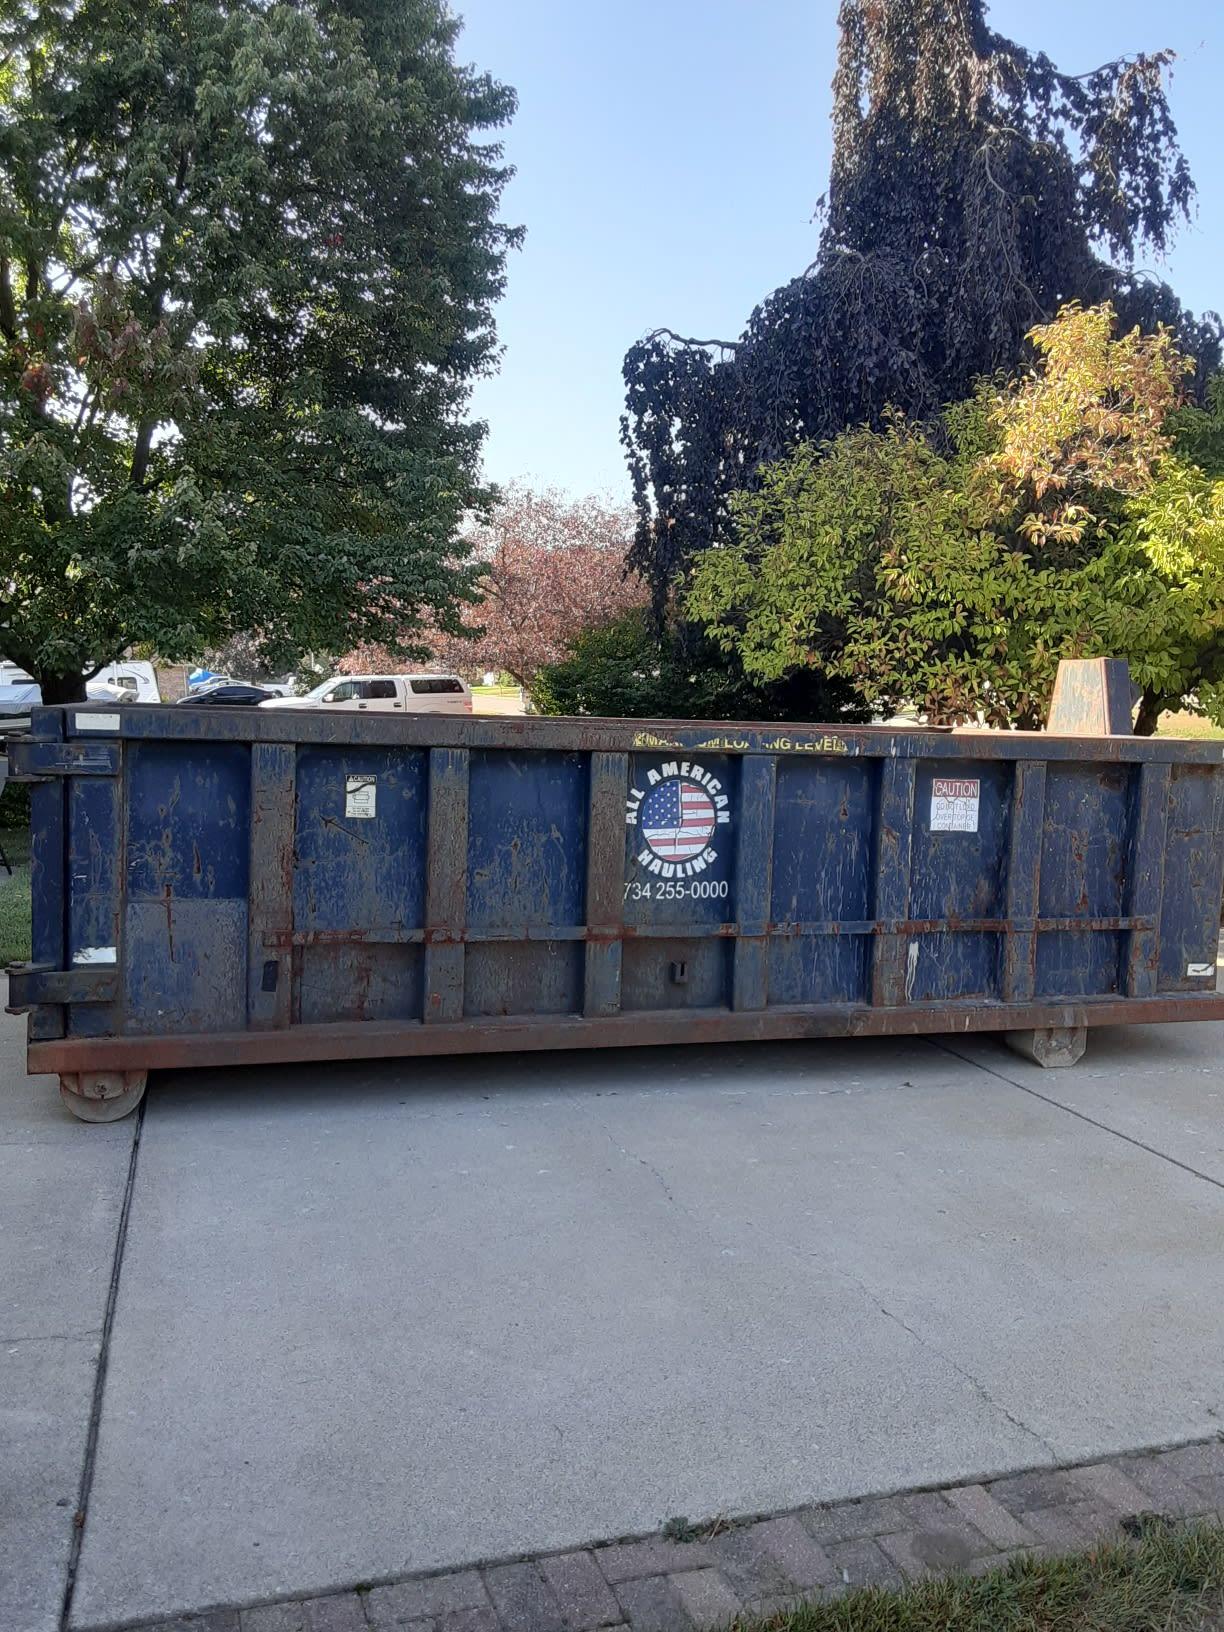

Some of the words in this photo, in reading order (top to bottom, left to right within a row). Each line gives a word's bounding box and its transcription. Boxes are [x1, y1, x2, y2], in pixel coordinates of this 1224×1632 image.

[625, 788, 646, 824] ALL
[646, 761, 730, 824] AMERICAN
[935, 782, 977, 797] CAUTION
[637, 847, 718, 878] HAULING
[624, 882, 651, 900] 734
[656, 881, 729, 900] 255-0000
